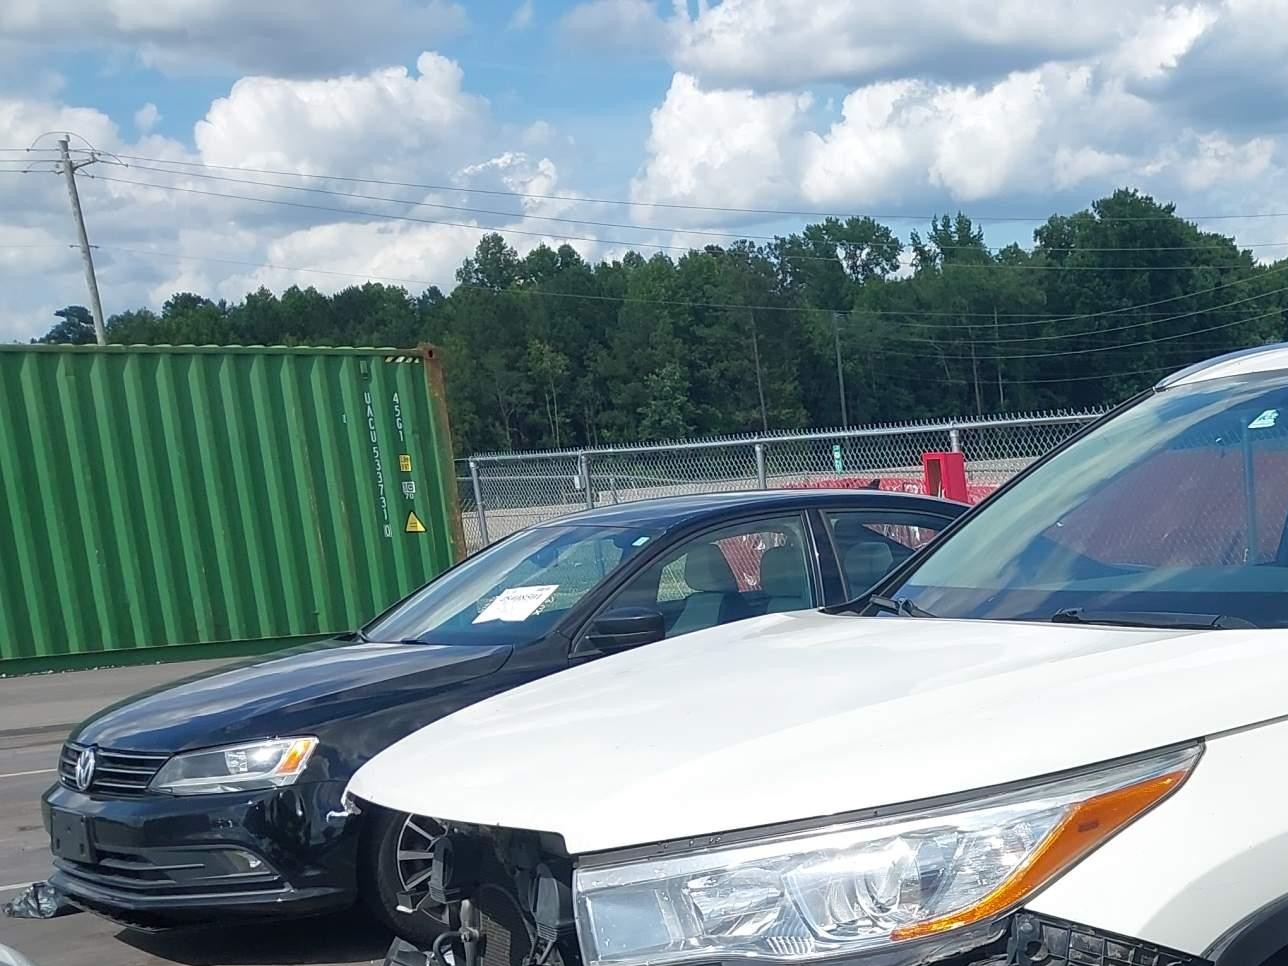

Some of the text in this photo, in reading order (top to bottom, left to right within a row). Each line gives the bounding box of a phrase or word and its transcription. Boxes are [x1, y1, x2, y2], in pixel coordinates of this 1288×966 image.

[364, 391, 377, 443] UACU
[373, 446, 388, 521] 533731
[392, 392, 404, 442] 45G1
